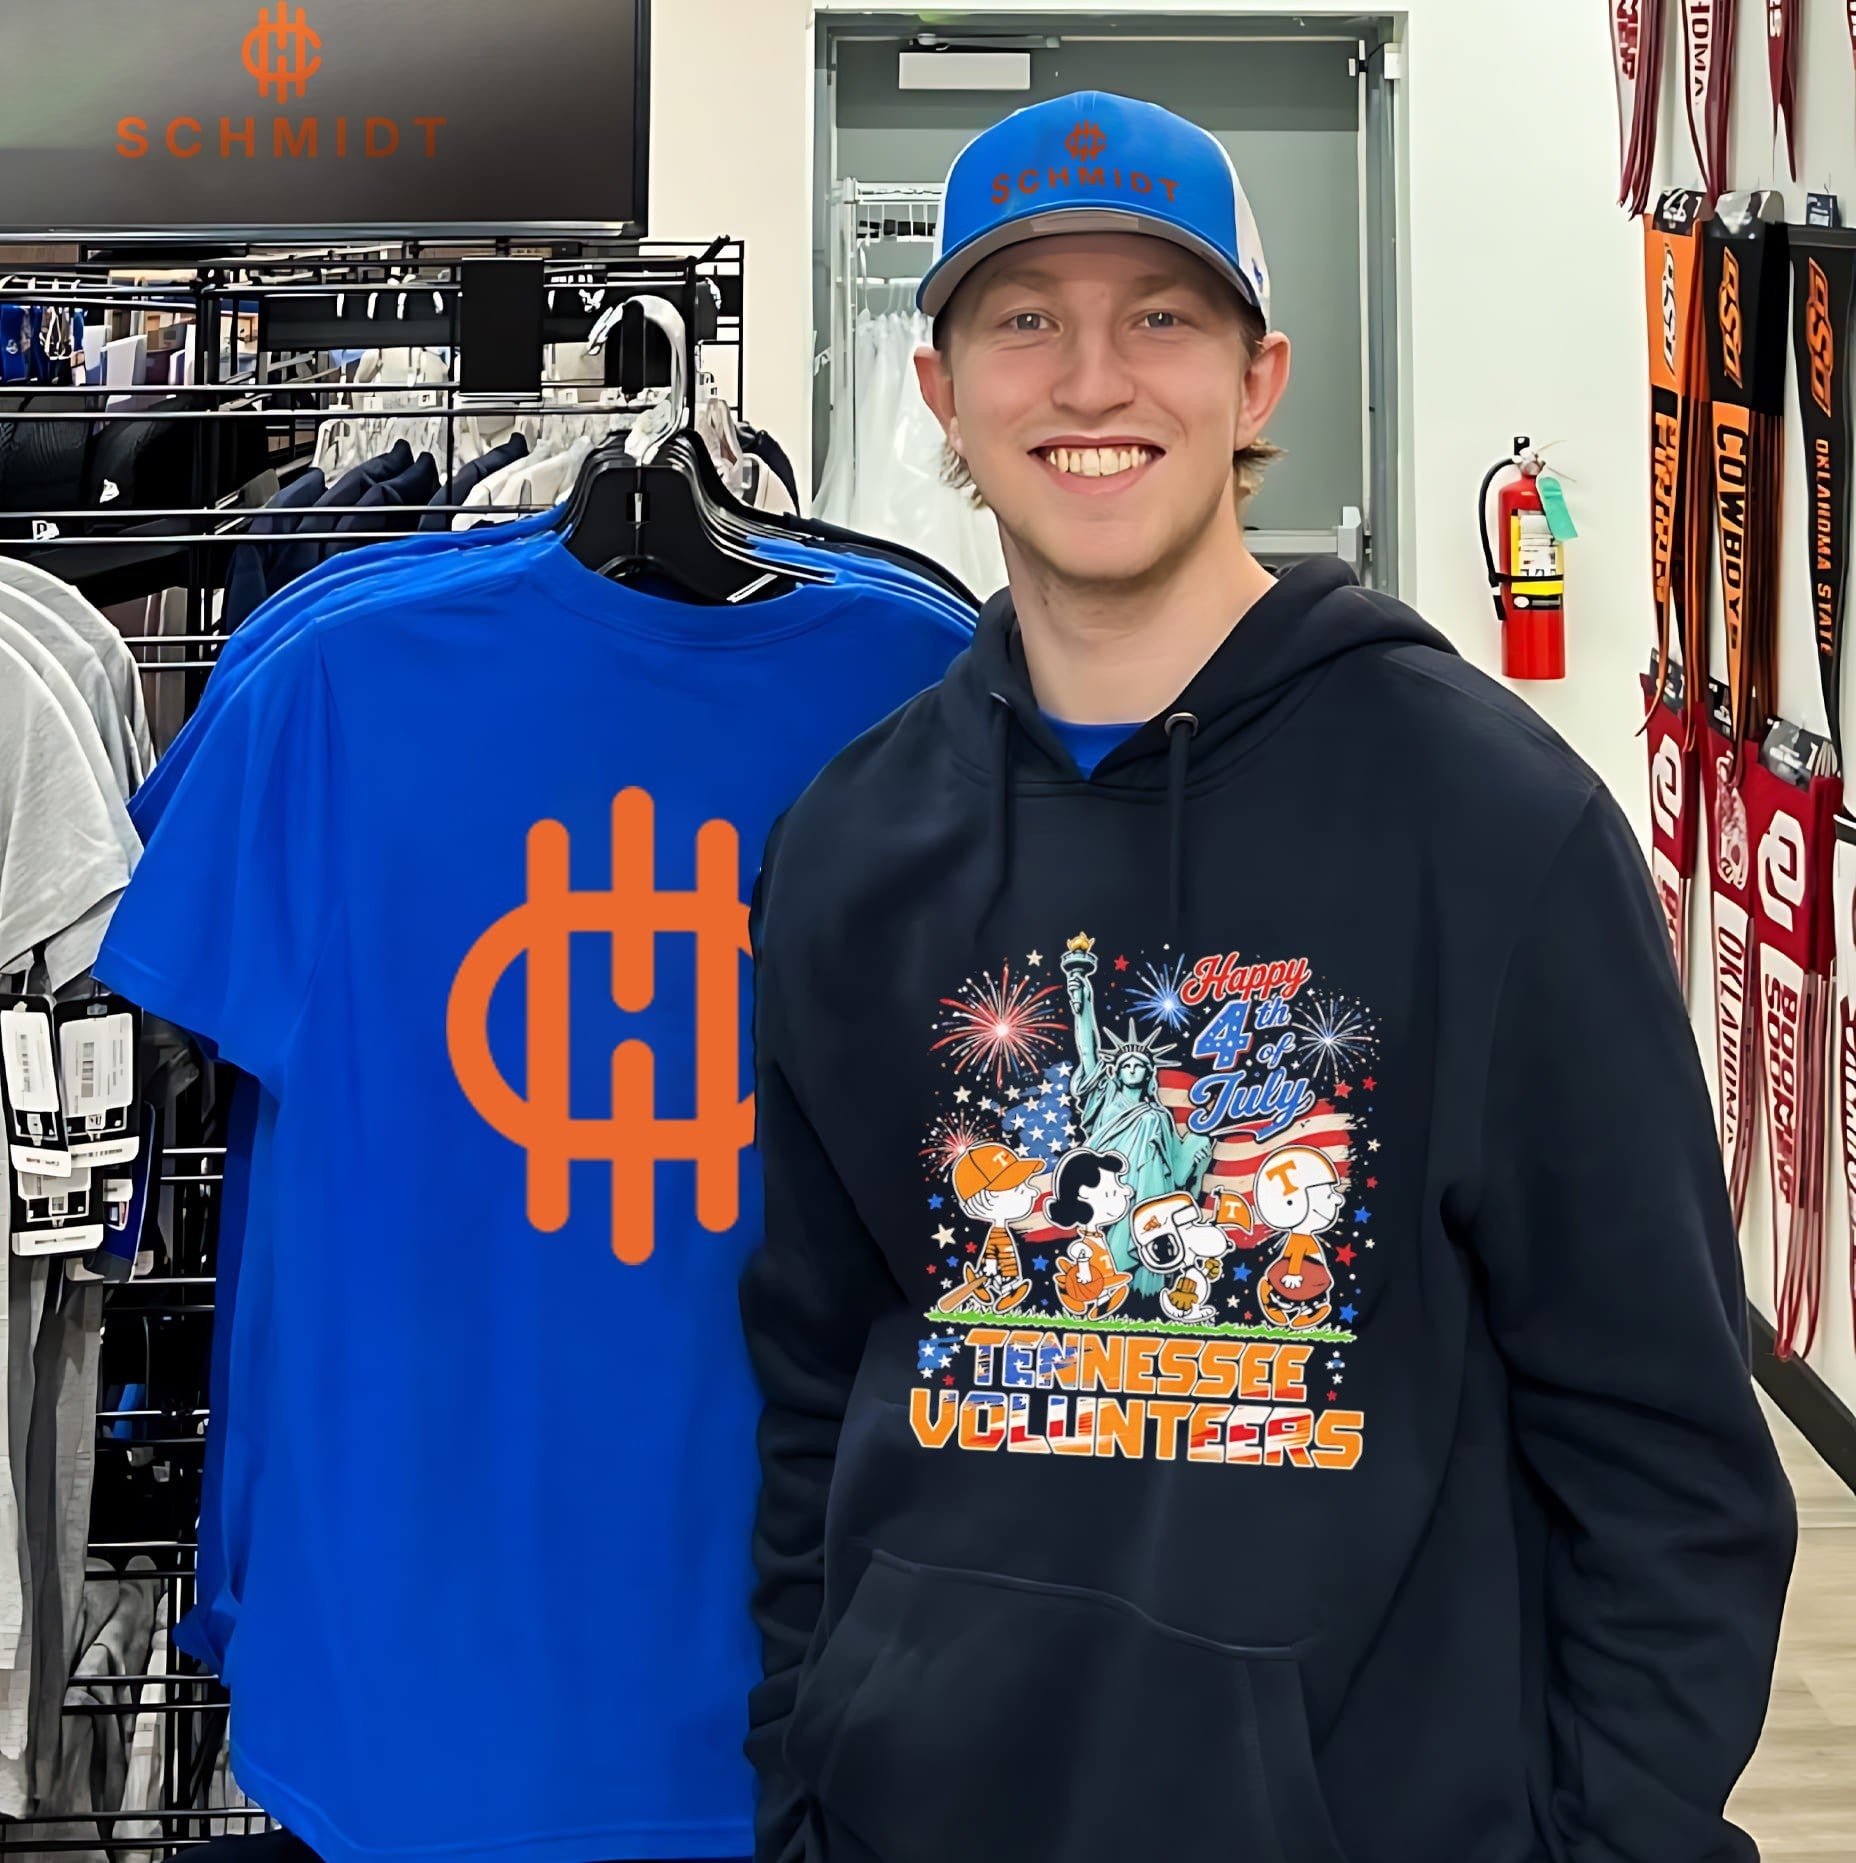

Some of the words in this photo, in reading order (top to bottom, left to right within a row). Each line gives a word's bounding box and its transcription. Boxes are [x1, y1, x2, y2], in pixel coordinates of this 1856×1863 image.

[115, 115, 447, 159] SCHMIDT
[991, 166, 1179, 205] SCHMIDT
[1815, 438, 1833, 571] OKLAHOMA
[1817, 582, 1833, 657] STATE
[1180, 951, 1312, 1006] Happy
[1256, 1031, 1296, 1069] of
[1718, 930, 1744, 1144] OKLAHOMA
[1188, 1066, 1316, 1141] July
[1224, 1200, 1242, 1219] T
[1265, 1160, 1299, 1197] T
[963, 1327, 1315, 1402] TENNESSEE
[909, 1387, 1365, 1470] VOLUNTEERS
